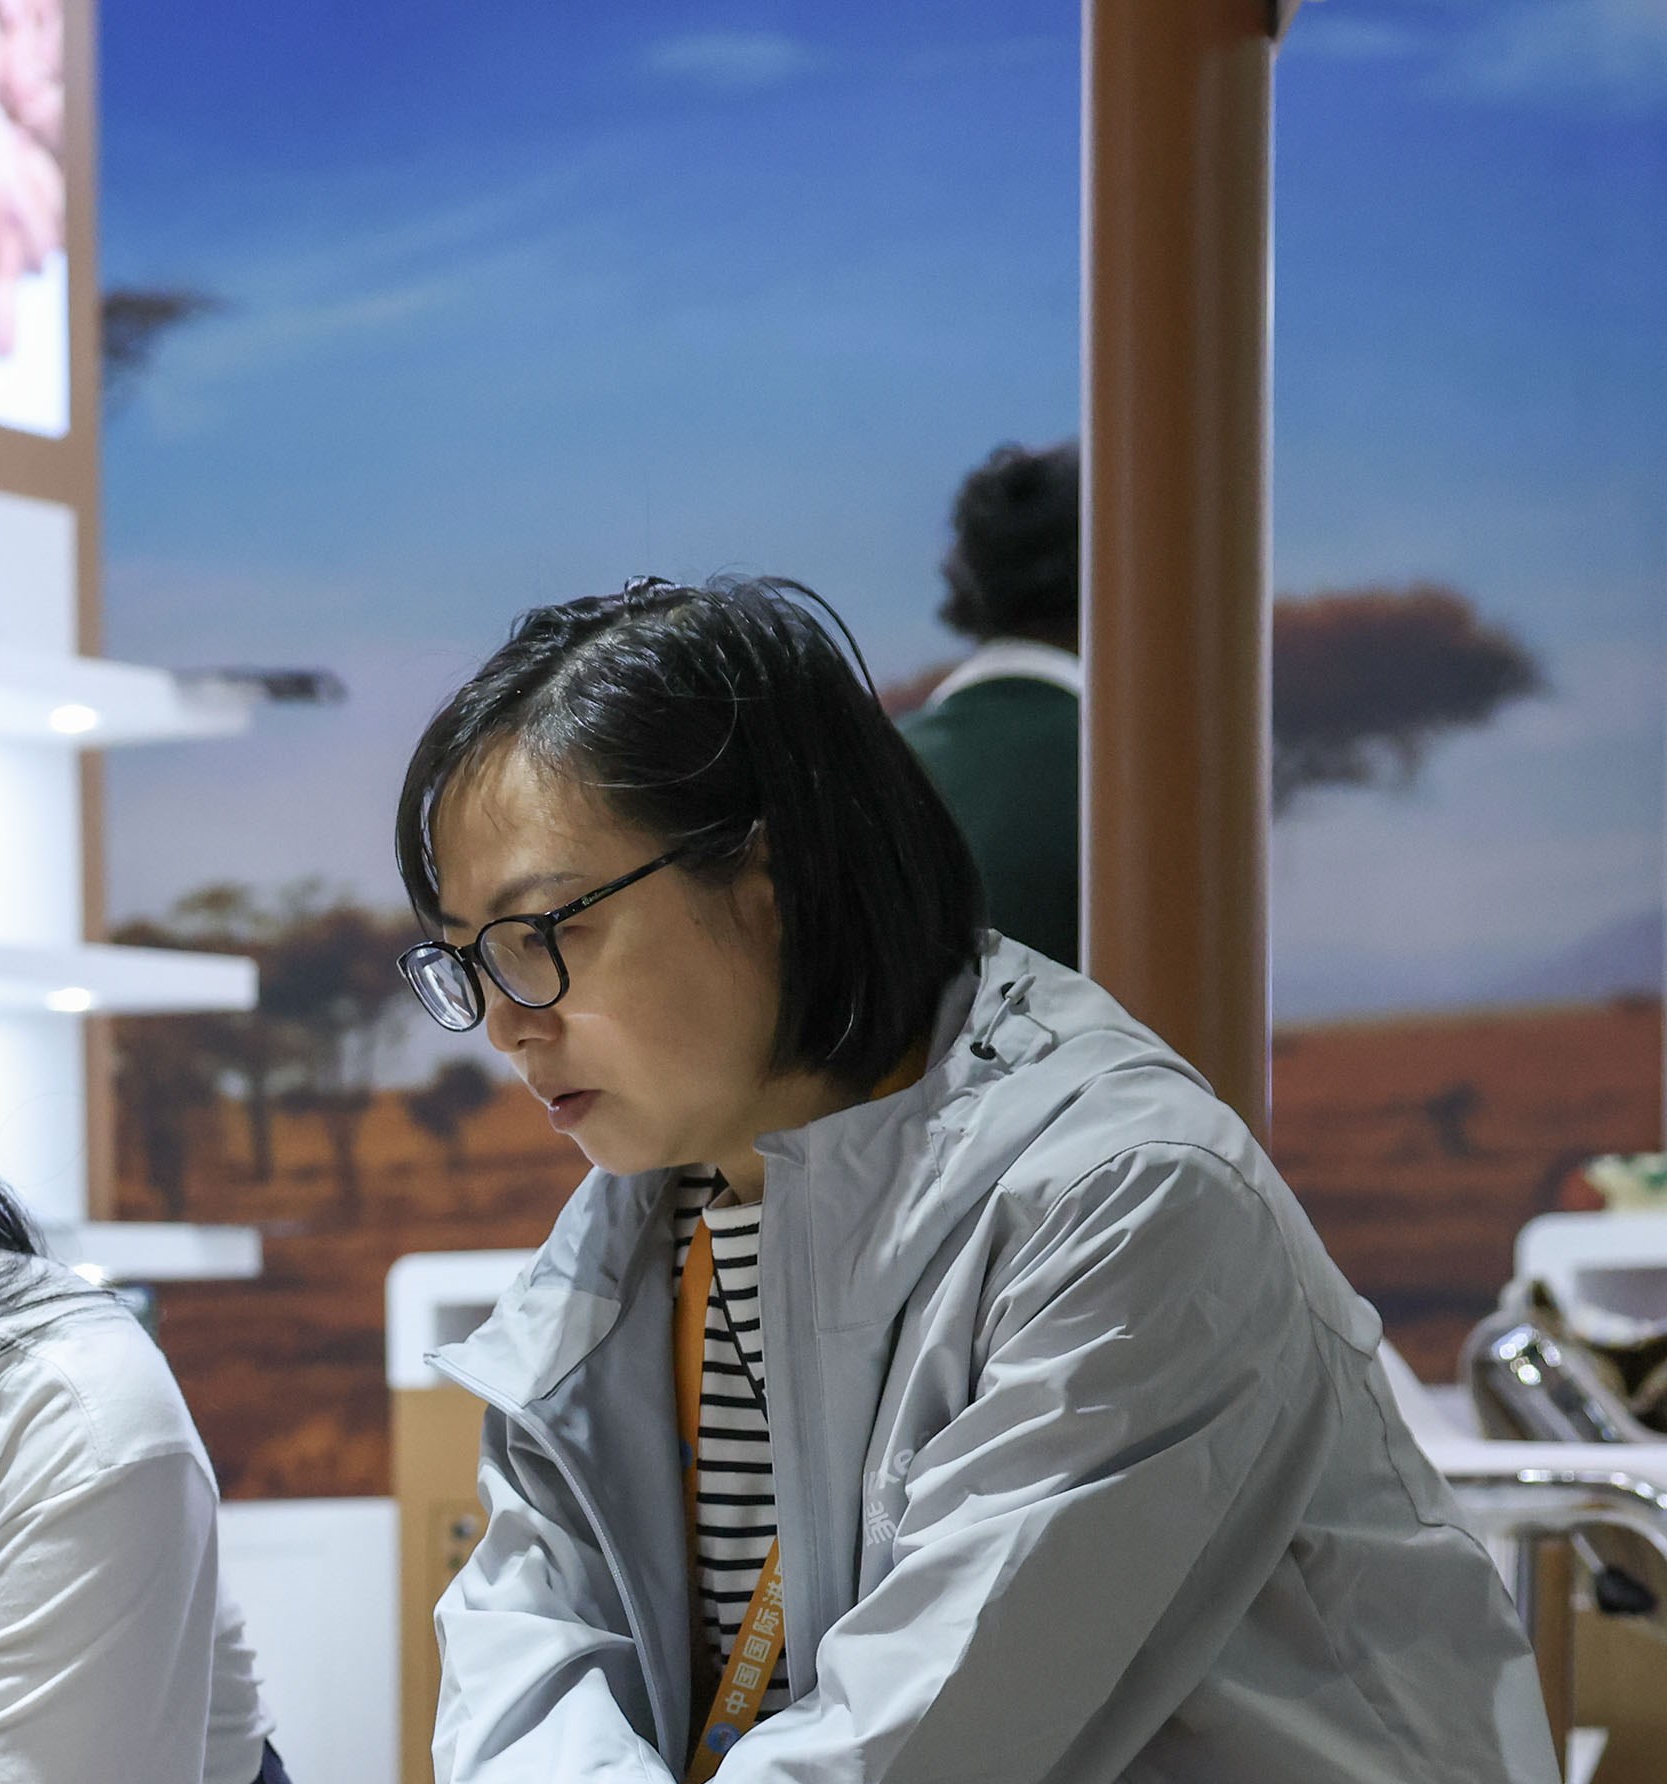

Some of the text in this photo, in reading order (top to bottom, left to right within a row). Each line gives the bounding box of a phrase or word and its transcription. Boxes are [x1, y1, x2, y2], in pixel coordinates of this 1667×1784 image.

[724, 1559, 783, 1715] 中国国际进
